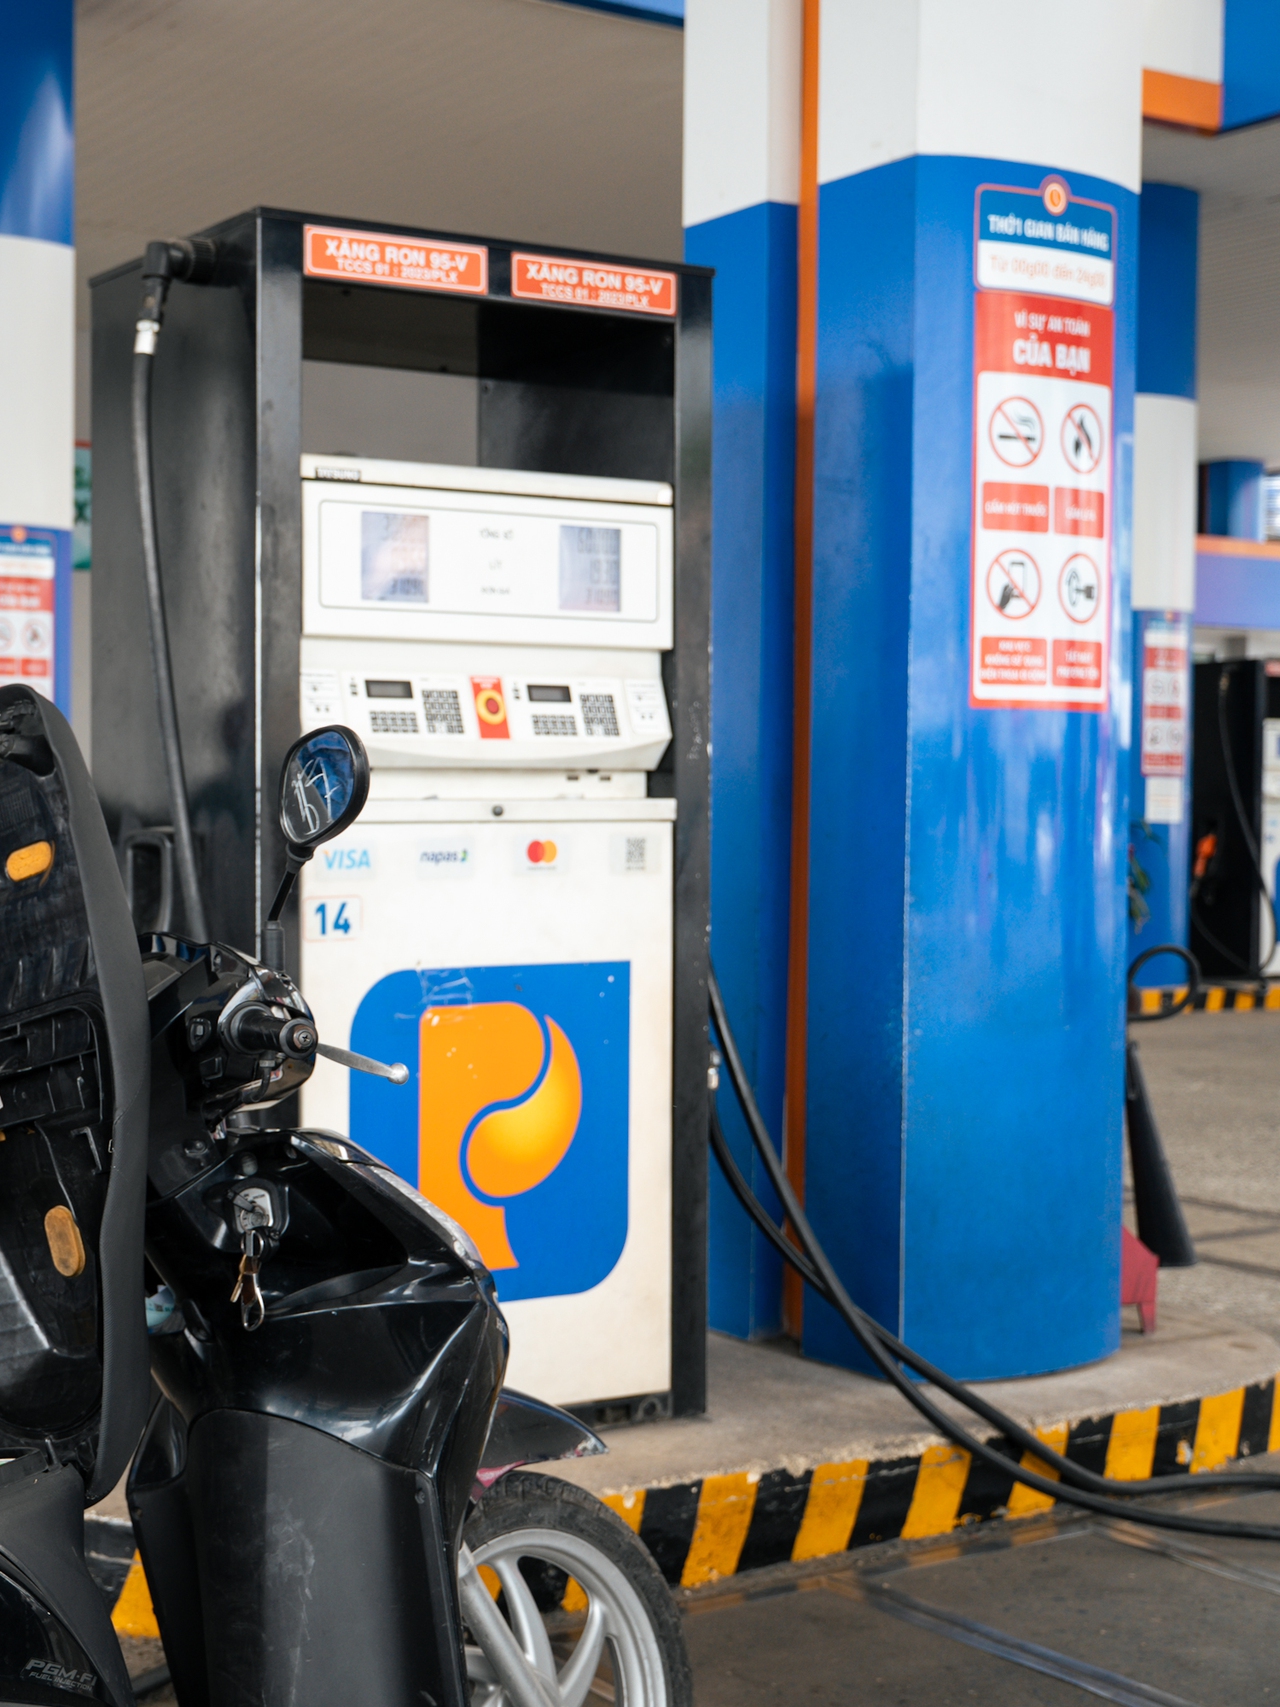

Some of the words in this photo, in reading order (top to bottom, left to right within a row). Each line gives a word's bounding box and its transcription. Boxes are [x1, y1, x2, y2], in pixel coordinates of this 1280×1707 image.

[988, 212, 1022, 236] THỜI
[1024, 218, 1054, 240] GIAN
[1056, 222, 1079, 246] BÁN
[325, 237, 380, 262] XĂNG
[385, 246, 426, 267] RON
[430, 251, 469, 272] 95-V
[336, 257, 373, 274] TCCS
[375, 264, 390, 276] 01
[526, 262, 579, 285] XĂNG
[582, 269, 622, 290] RON
[624, 275, 663, 295] 95-V
[540, 283, 573, 299] TCCS
[1014, 310, 1028, 328] VÌ
[1048, 316, 1063, 334] AN
[1064, 315, 1091, 338] TOÀN
[1013, 333, 1053, 367] CỦA
[1055, 343, 1091, 376] BẠN
[322, 849, 371, 870] VISA
[420, 851, 457, 866] napas
[315, 902, 351, 936] 14
[28, 1671, 53, 1682] FUEL
[53, 1676, 93, 1692] INJECTION
